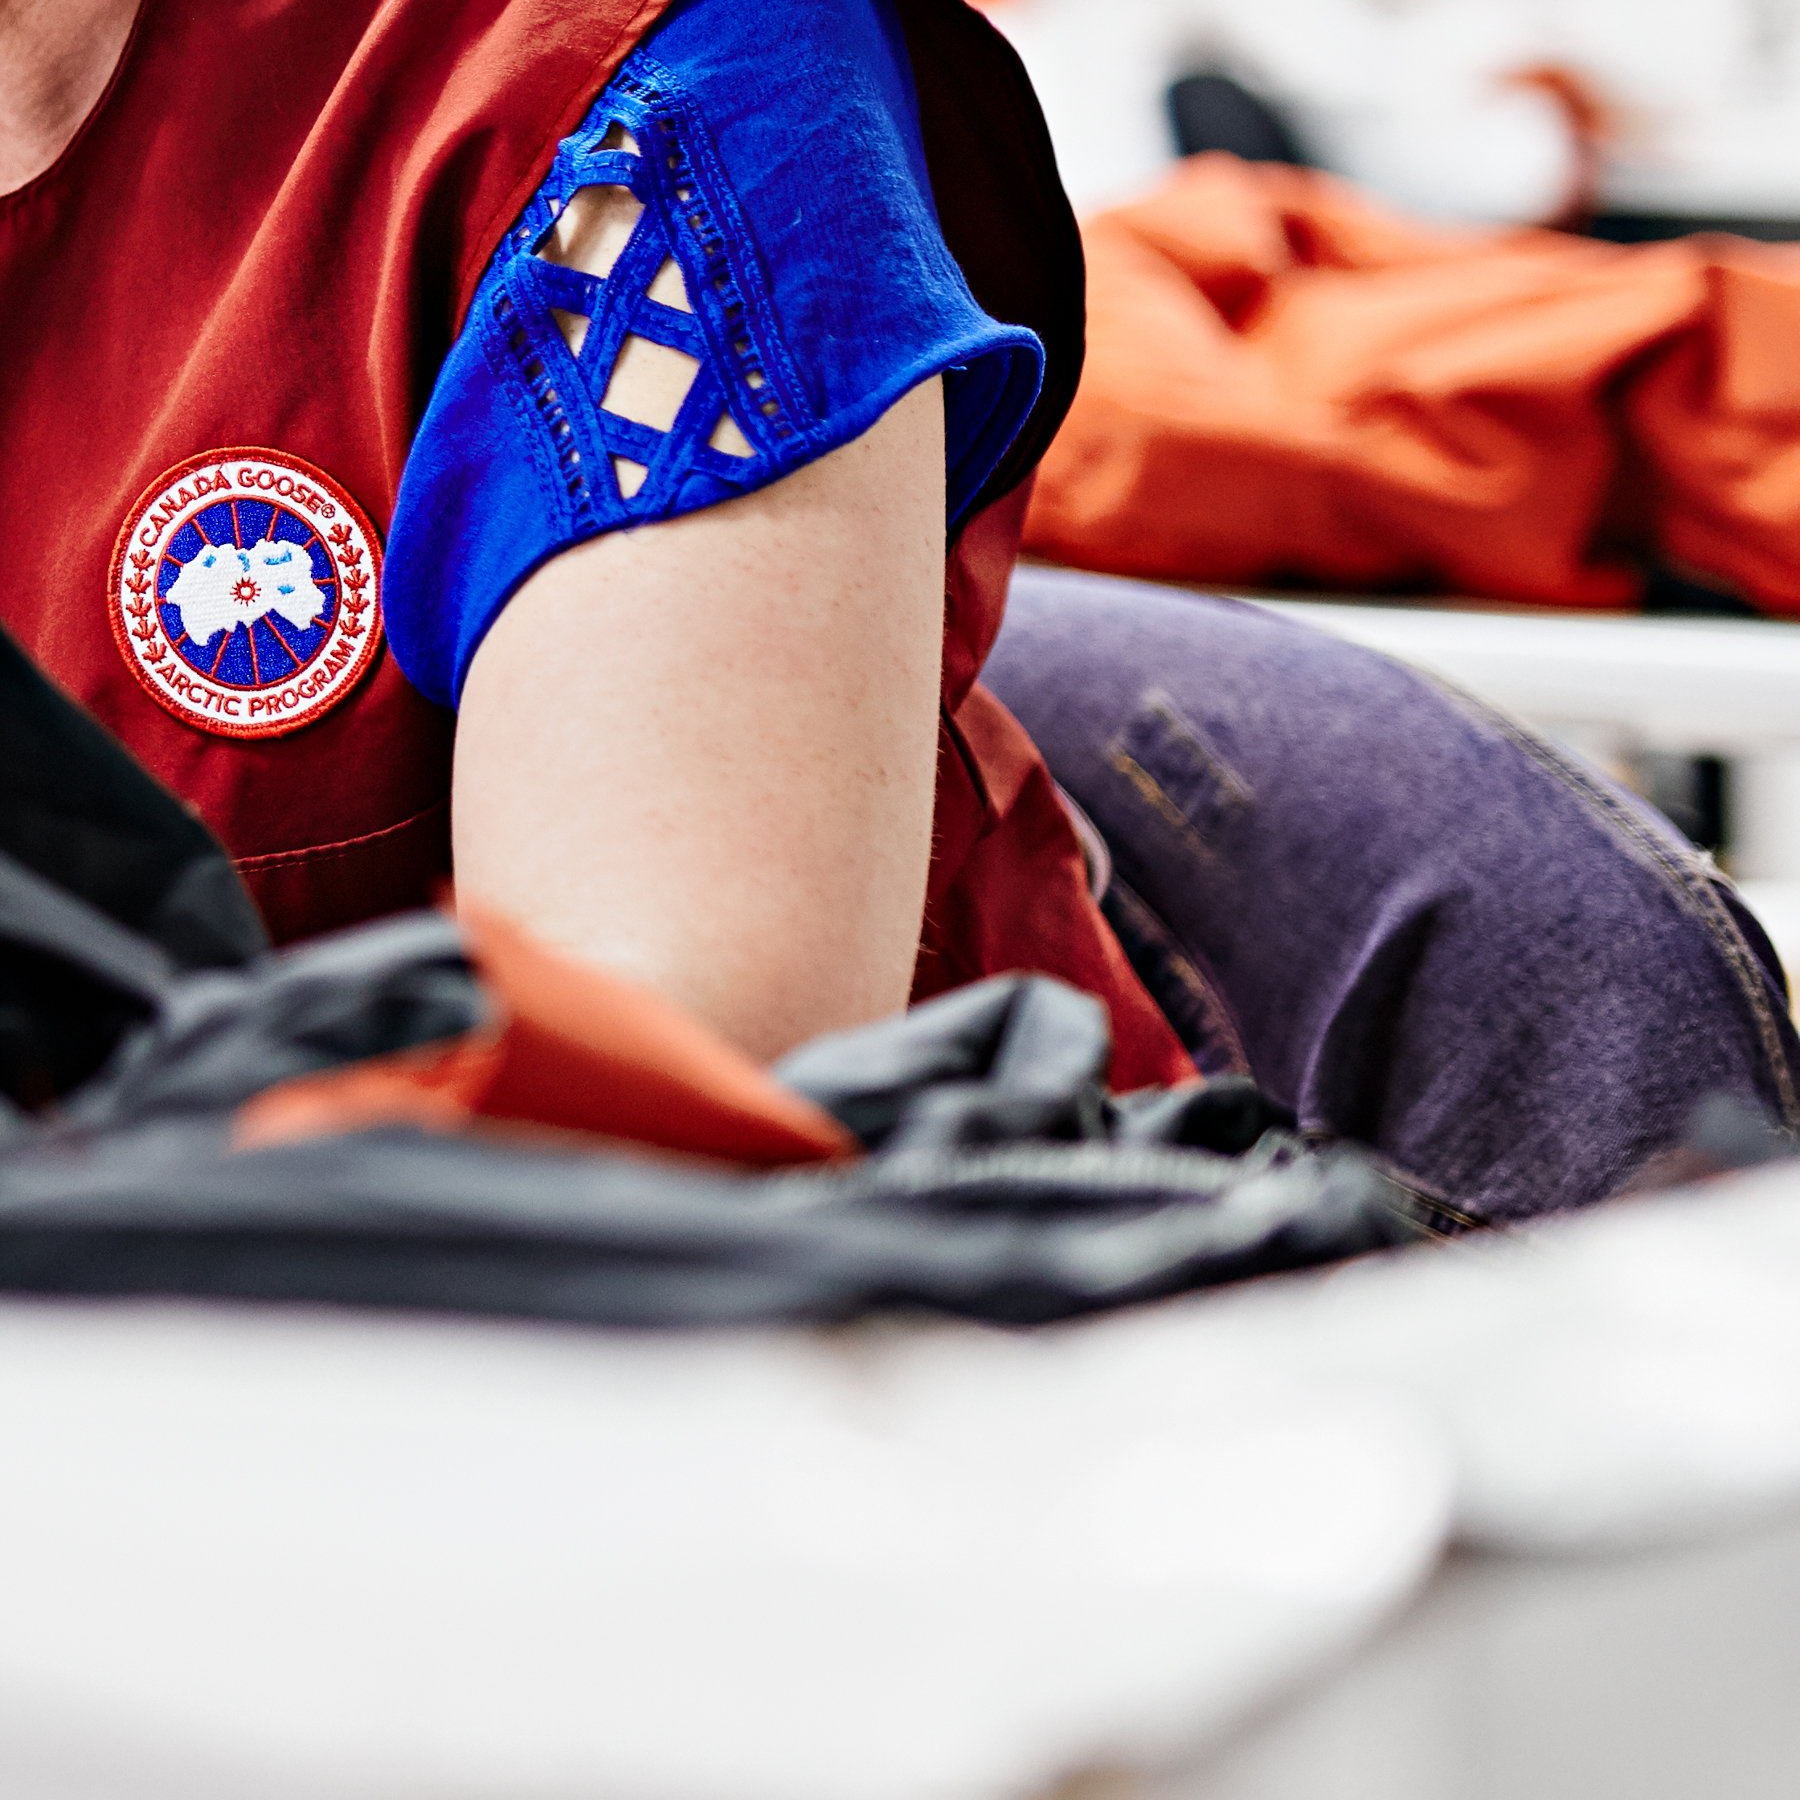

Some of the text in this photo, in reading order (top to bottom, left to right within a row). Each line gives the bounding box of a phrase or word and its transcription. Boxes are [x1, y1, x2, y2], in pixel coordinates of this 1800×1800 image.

[138, 469, 232, 547] CANADA
[156, 638, 357, 717] ARCTIC PROGRAM
